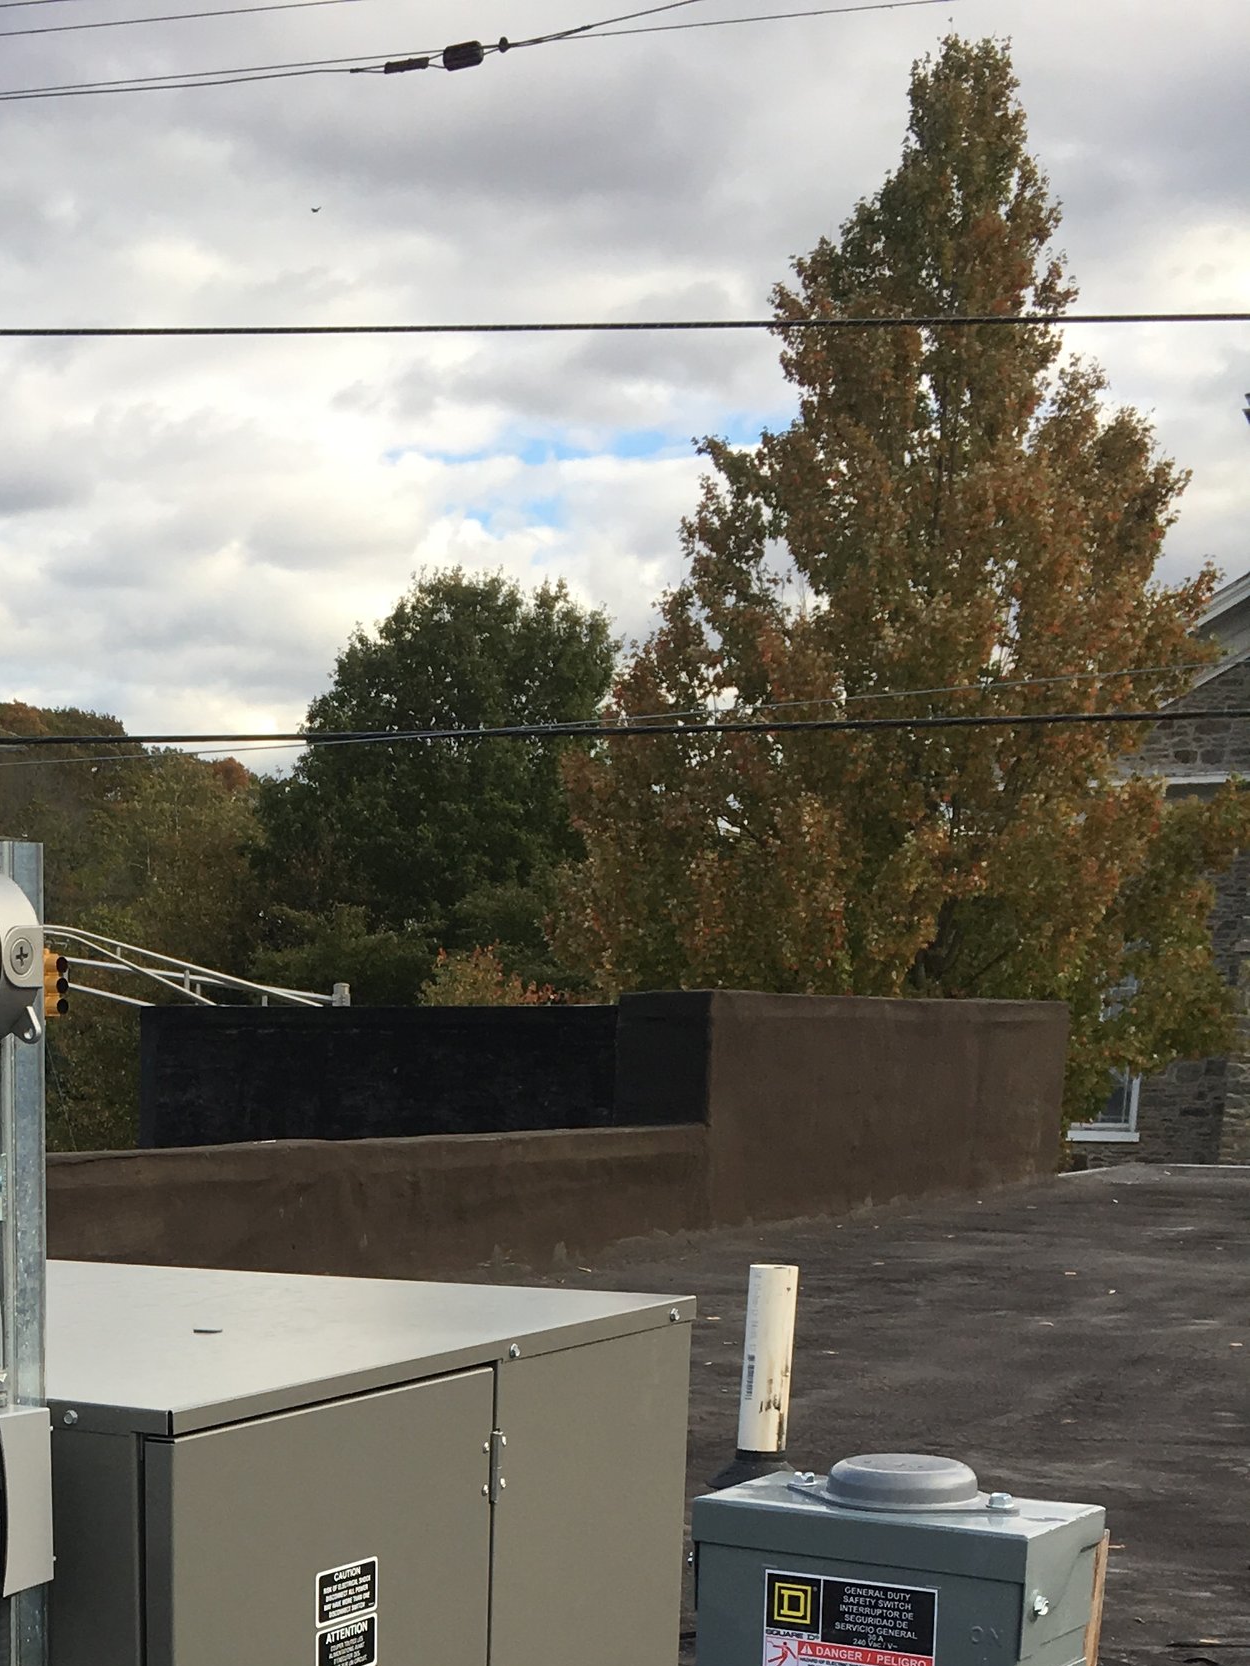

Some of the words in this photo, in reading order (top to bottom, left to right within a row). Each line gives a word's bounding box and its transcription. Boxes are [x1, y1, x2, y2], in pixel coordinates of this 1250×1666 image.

[334, 1567, 361, 1582] CAUTION
[845, 1587, 886, 1598] GENERAL
[888, 1592, 910, 1601] DUTY
[843, 1596, 876, 1606] SAFETY
[878, 1600, 911, 1610] SWITCH
[840, 1604, 900, 1619] INTERRUPTOR
[903, 1612, 914, 1620] DE
[845, 1614, 895, 1627] SEGURIDAD
[326, 1620, 368, 1644] ATTENTION
[766, 1629, 803, 1639] SQUARE
[835, 1622, 874, 1634] SERVICIO
[876, 1628, 917, 1640] GENERAL
[816, 1646, 862, 1662] DANGER
